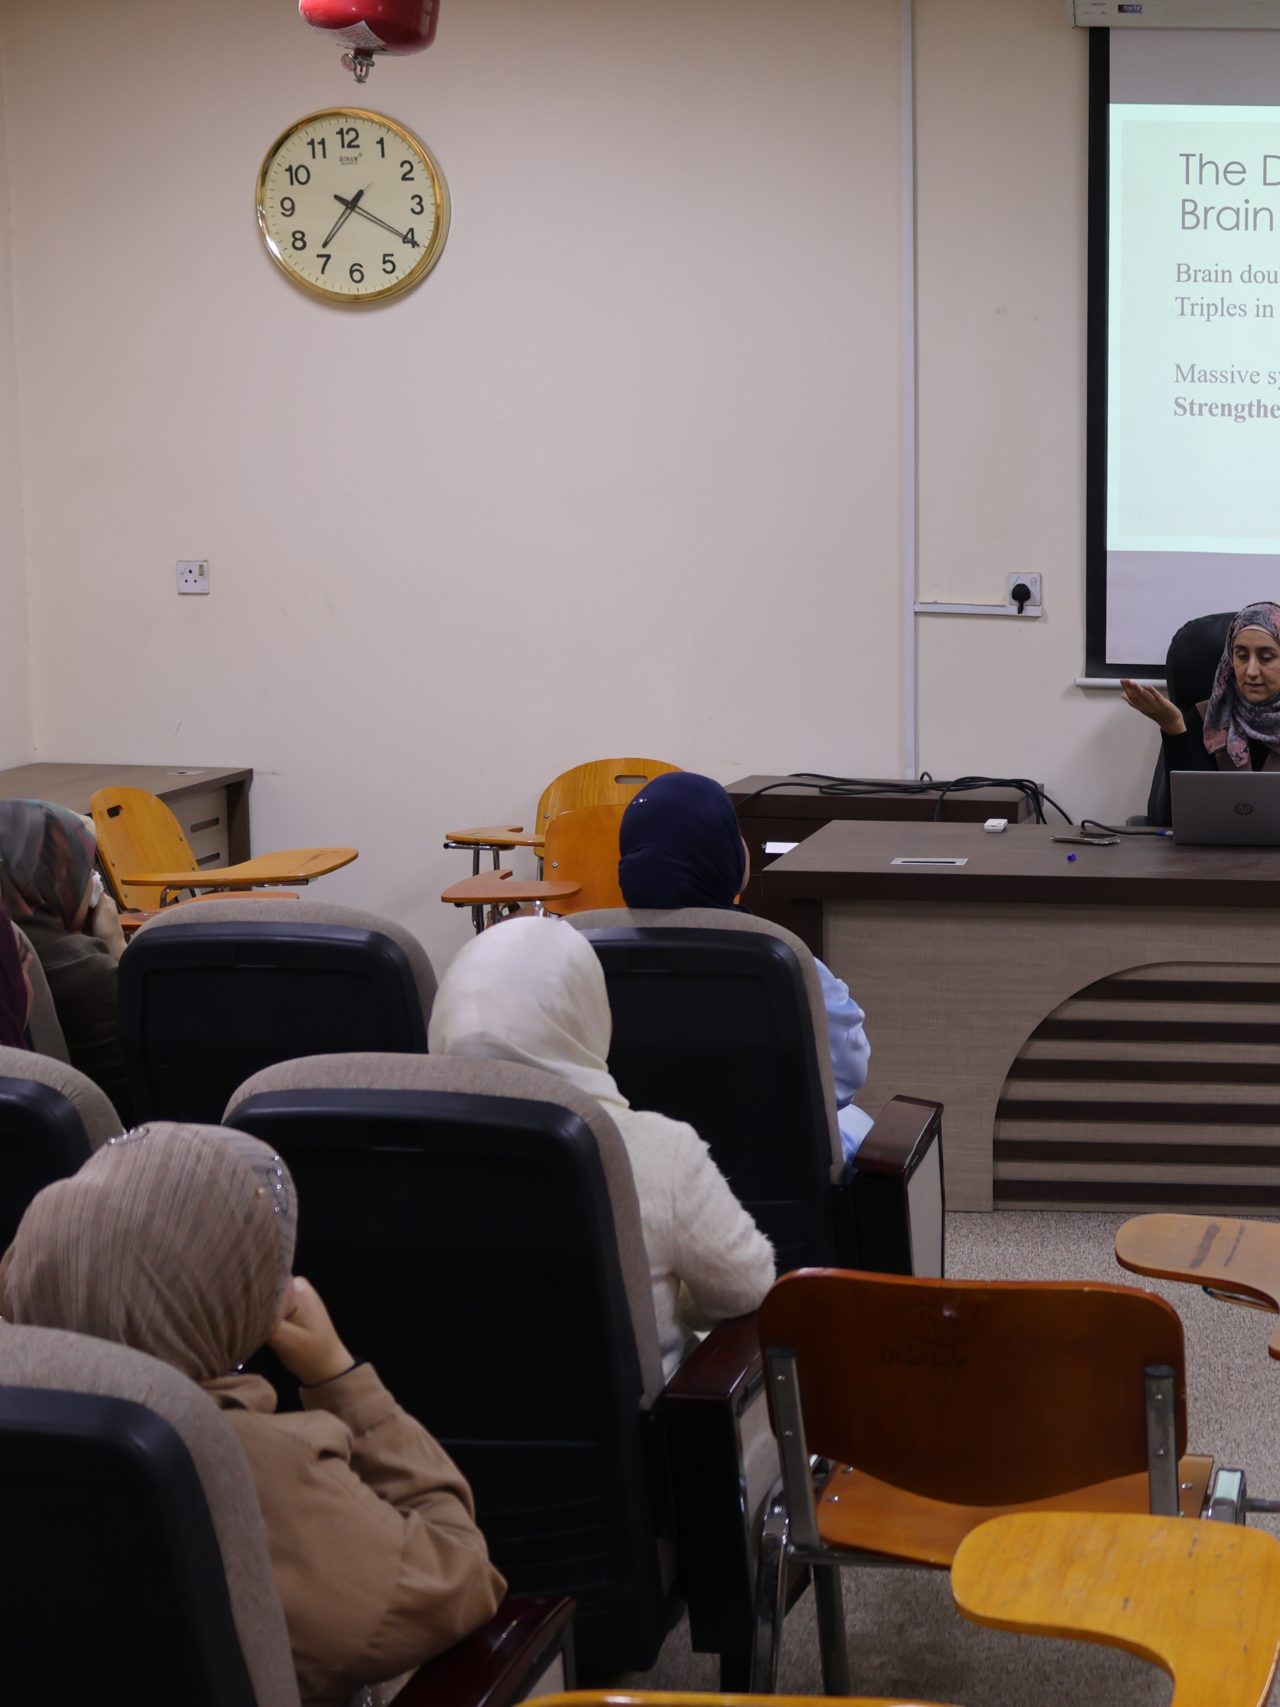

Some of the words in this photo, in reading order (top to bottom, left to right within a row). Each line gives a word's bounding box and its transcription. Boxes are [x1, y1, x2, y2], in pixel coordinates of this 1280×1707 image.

[306, 138, 326, 159] 11
[336, 127, 360, 149] 12
[376, 137, 385, 158] 1
[285, 164, 310, 186] 10
[400, 160, 414, 181] 2
[1179, 153, 1247, 186] The
[280, 196, 295, 217] 9
[410, 194, 424, 215] 3
[1180, 198, 1274, 232] Brain
[291, 230, 307, 251] 8
[402, 228, 416, 248] 4
[316, 254, 332, 274] 7
[349, 262, 364, 284] 6
[382, 253, 396, 274] 5
[1175, 262, 1233, 284] Brain
[1175, 296, 1248, 322] Triples
[1254, 298, 1275, 318] in
[1174, 363, 1261, 385] Massive
